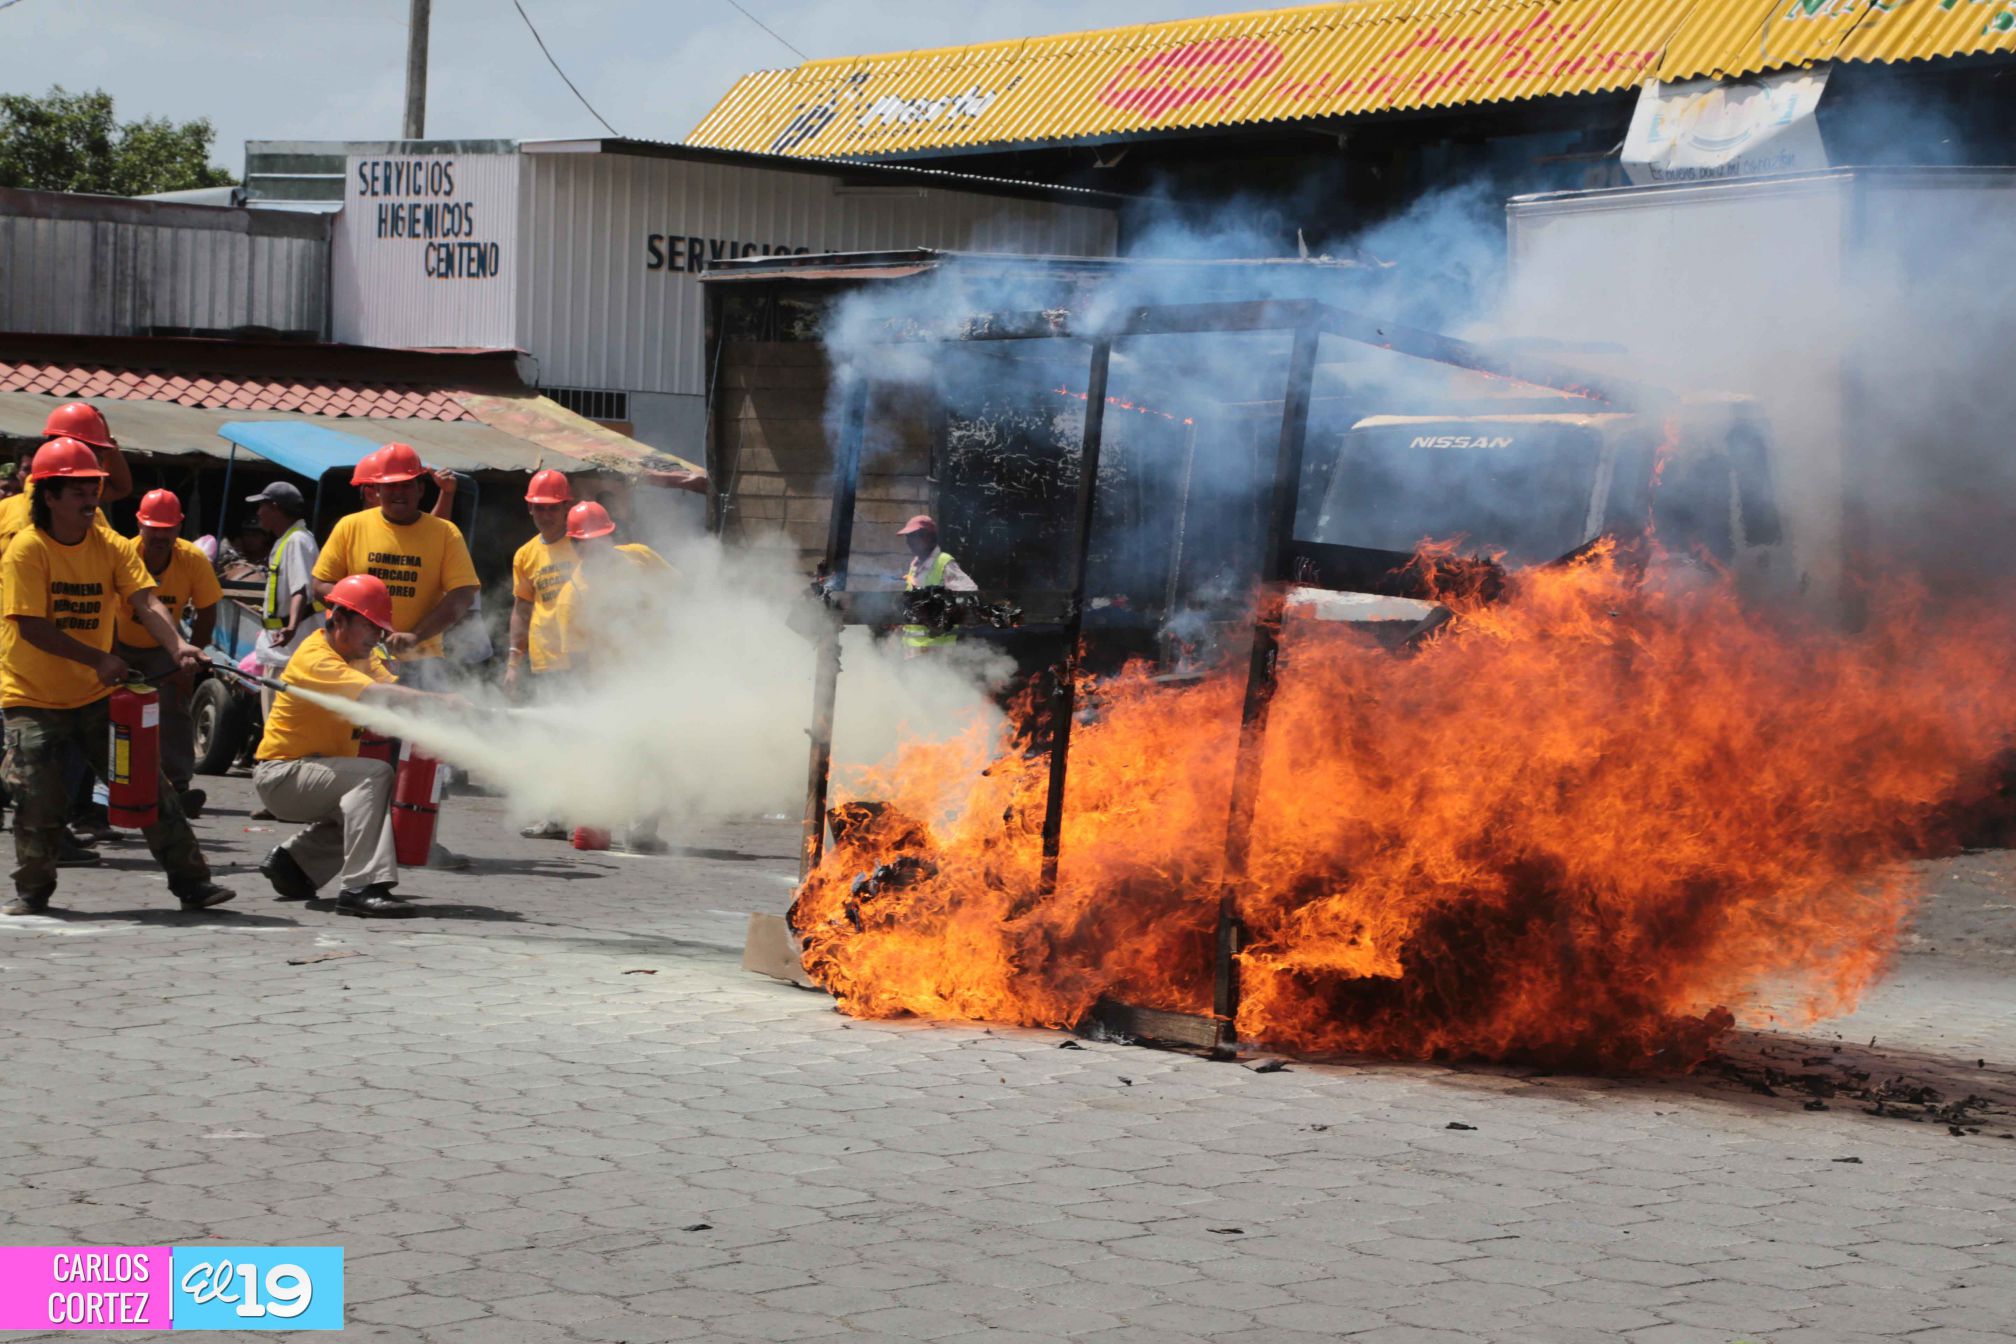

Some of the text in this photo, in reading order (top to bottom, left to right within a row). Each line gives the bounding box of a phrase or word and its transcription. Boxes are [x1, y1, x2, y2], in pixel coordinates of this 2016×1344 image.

[359, 161, 454, 196] SERVICIOS
[377, 202, 473, 239] HIGIENICOS
[425, 242, 499, 279] CENTENO
[647, 234, 809, 273] SERVI
[1409, 436, 1513, 449] NISSAN
[368, 552, 422, 567] COMMEMA
[368, 567, 418, 582] MERCADO
[386, 585, 416, 598] OREO
